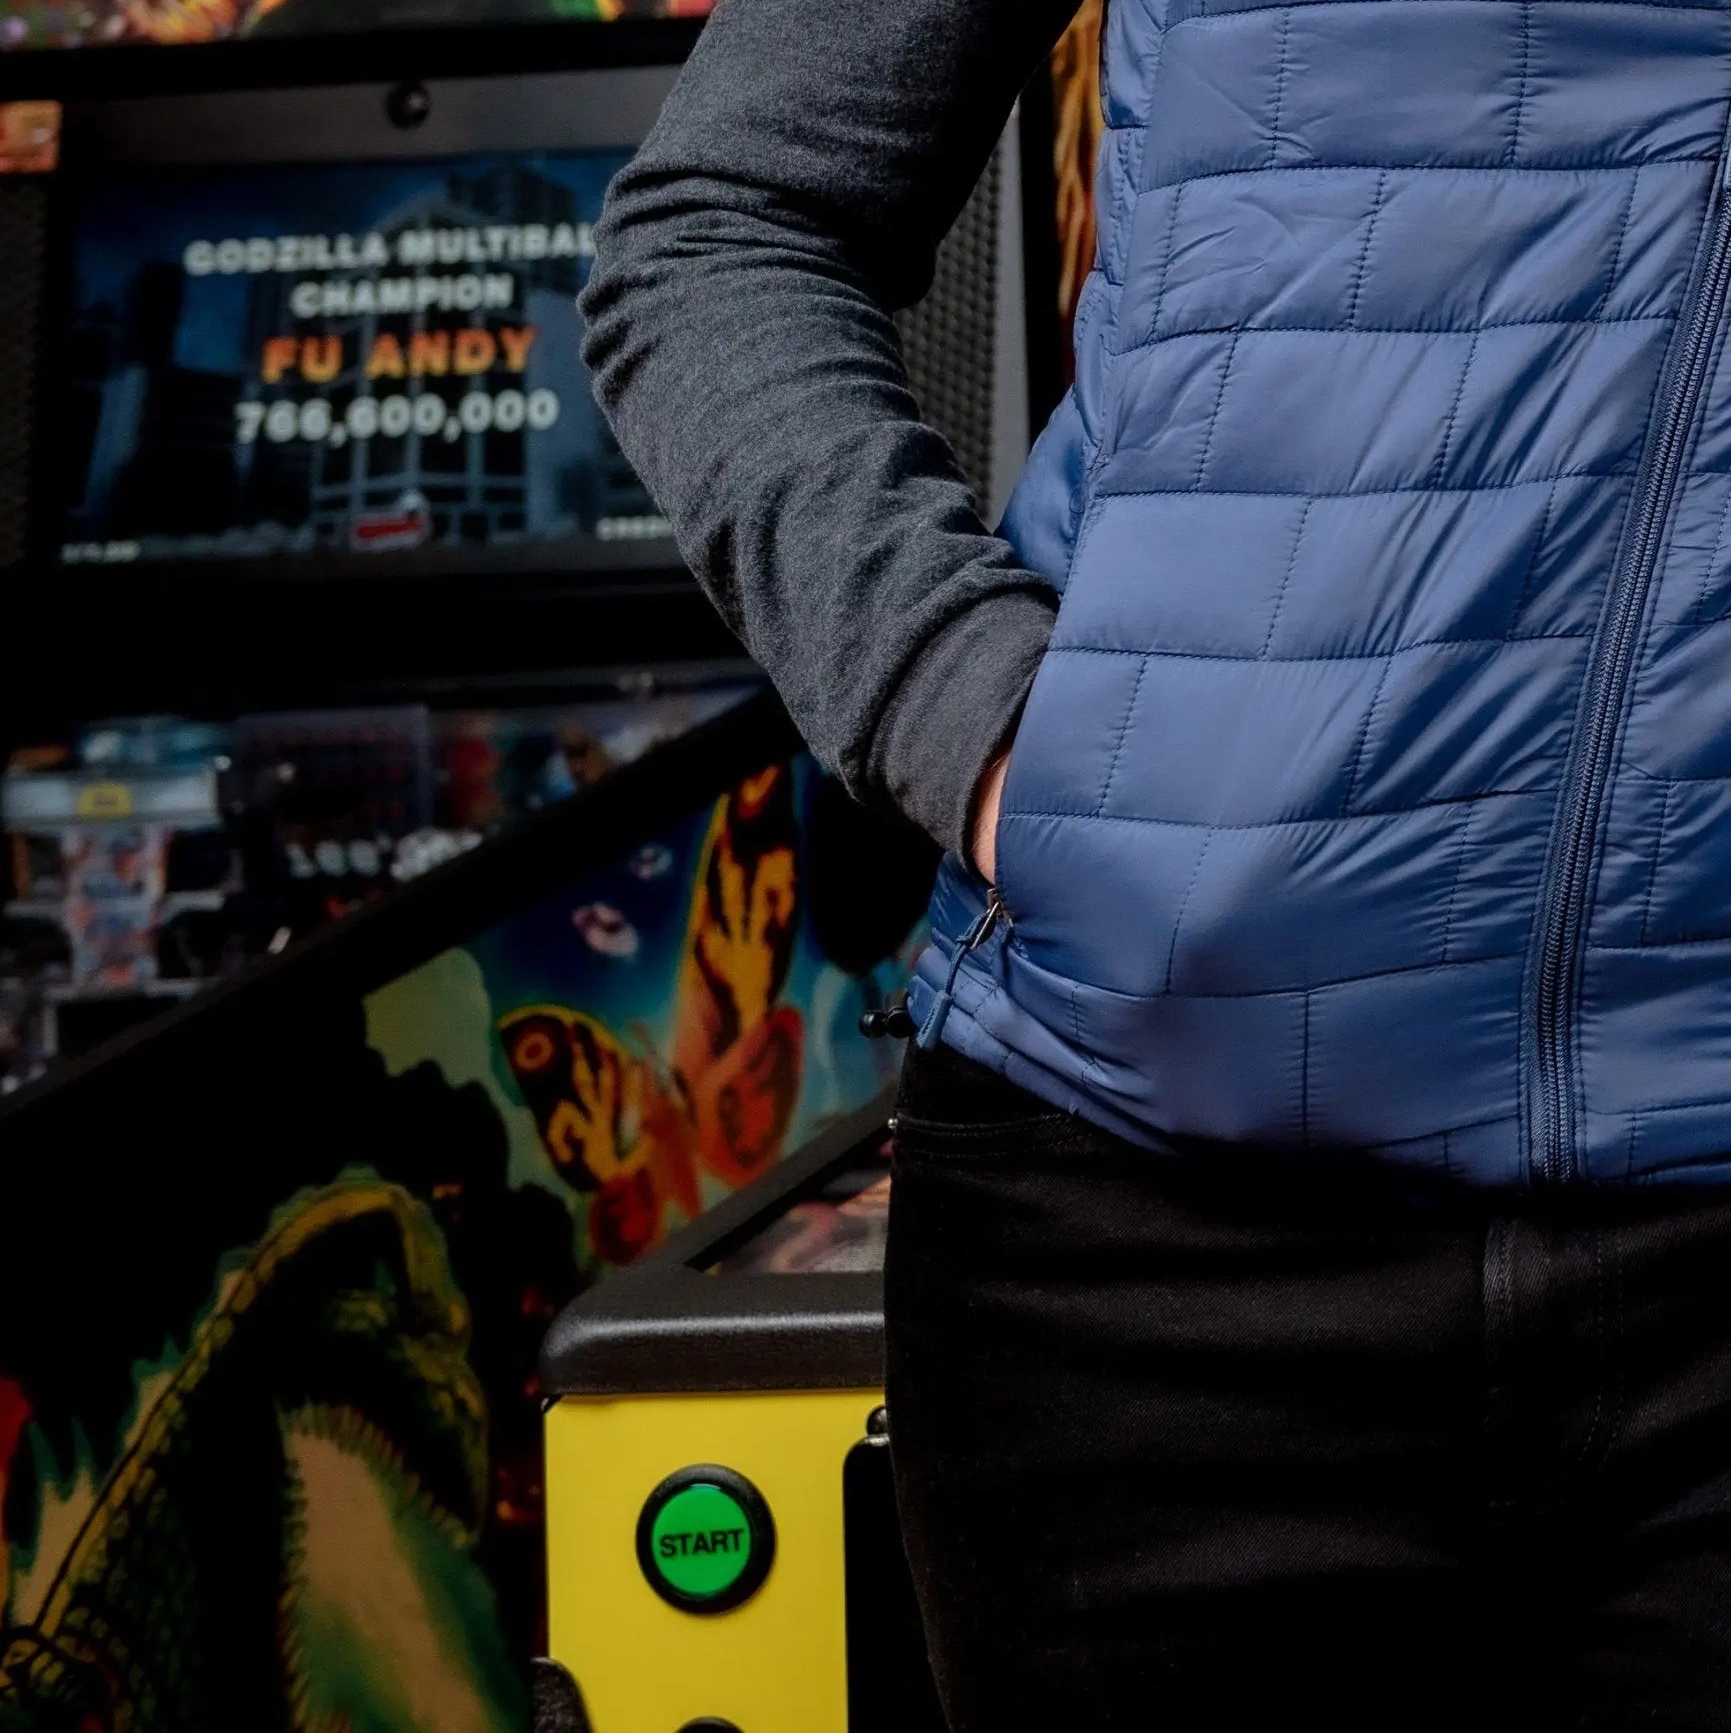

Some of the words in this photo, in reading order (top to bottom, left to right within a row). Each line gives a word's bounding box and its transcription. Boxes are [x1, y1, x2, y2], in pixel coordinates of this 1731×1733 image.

[184, 233, 390, 276] GODZILLA
[400, 223, 597, 265] MULTIBAL
[290, 272, 514, 318] CHAMPION
[262, 335, 343, 385] FU
[365, 325, 538, 380] ANDY
[659, 1527, 745, 1558] START
